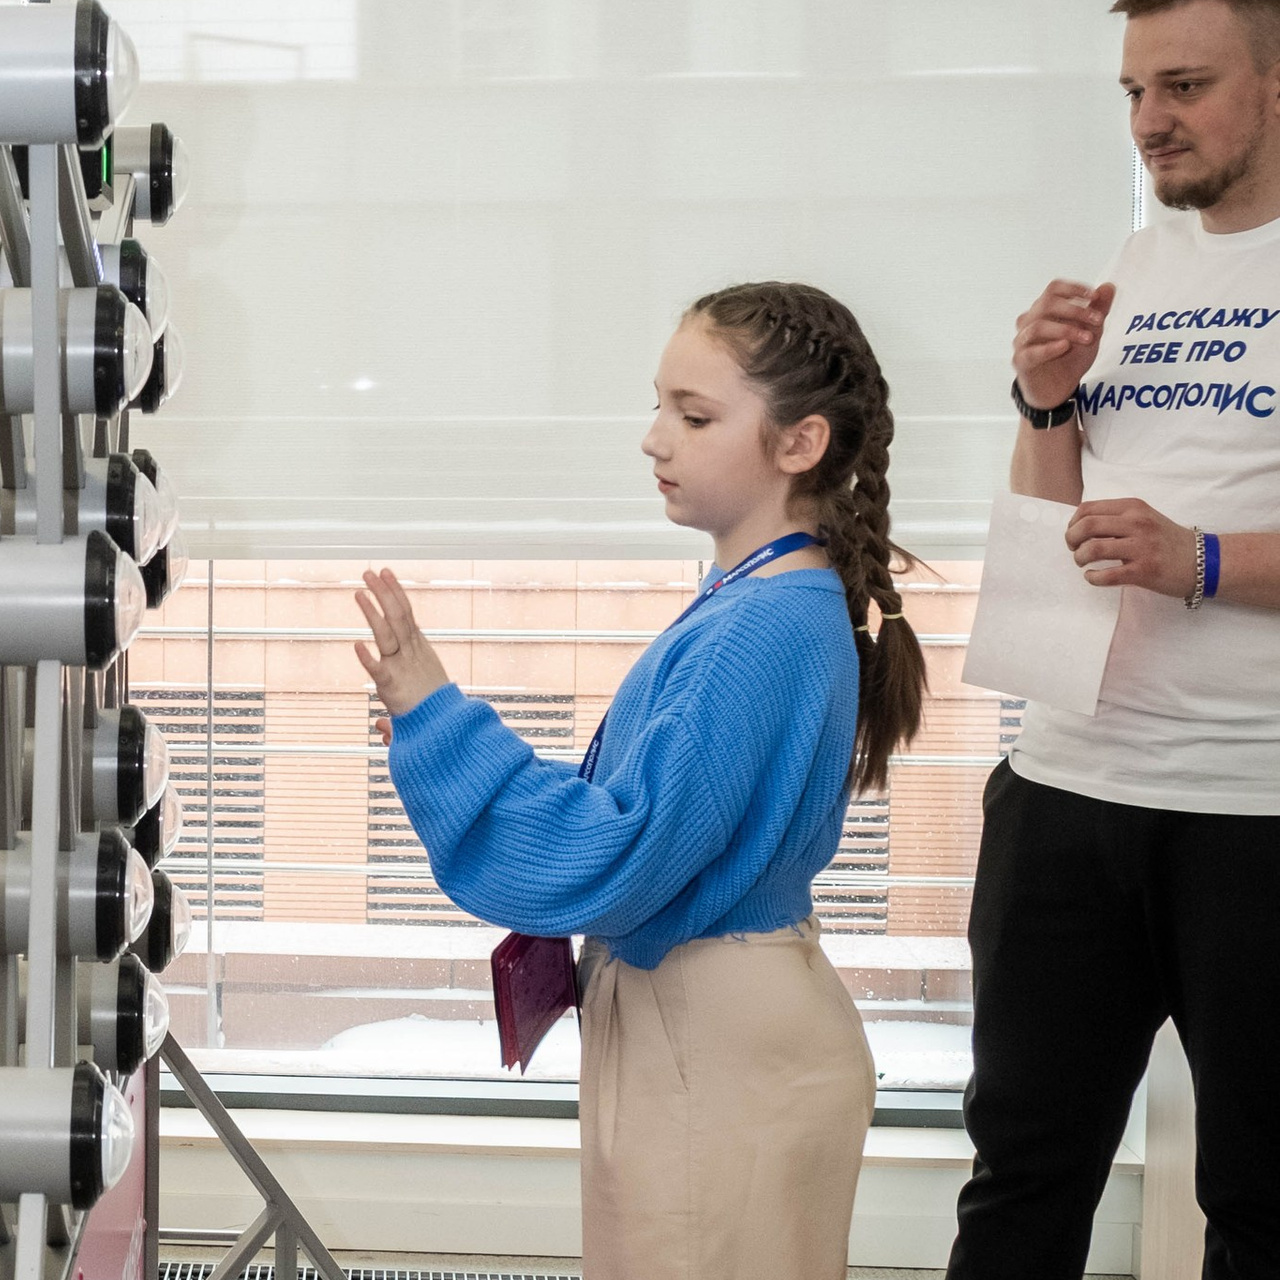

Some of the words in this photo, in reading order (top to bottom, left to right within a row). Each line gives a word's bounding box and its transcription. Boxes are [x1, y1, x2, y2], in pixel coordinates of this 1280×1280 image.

[1125, 307, 1280, 335] РАССКАЖУ
[1120, 342, 1183, 365] ТЕБЕ
[1185, 340, 1247, 363] ПРО
